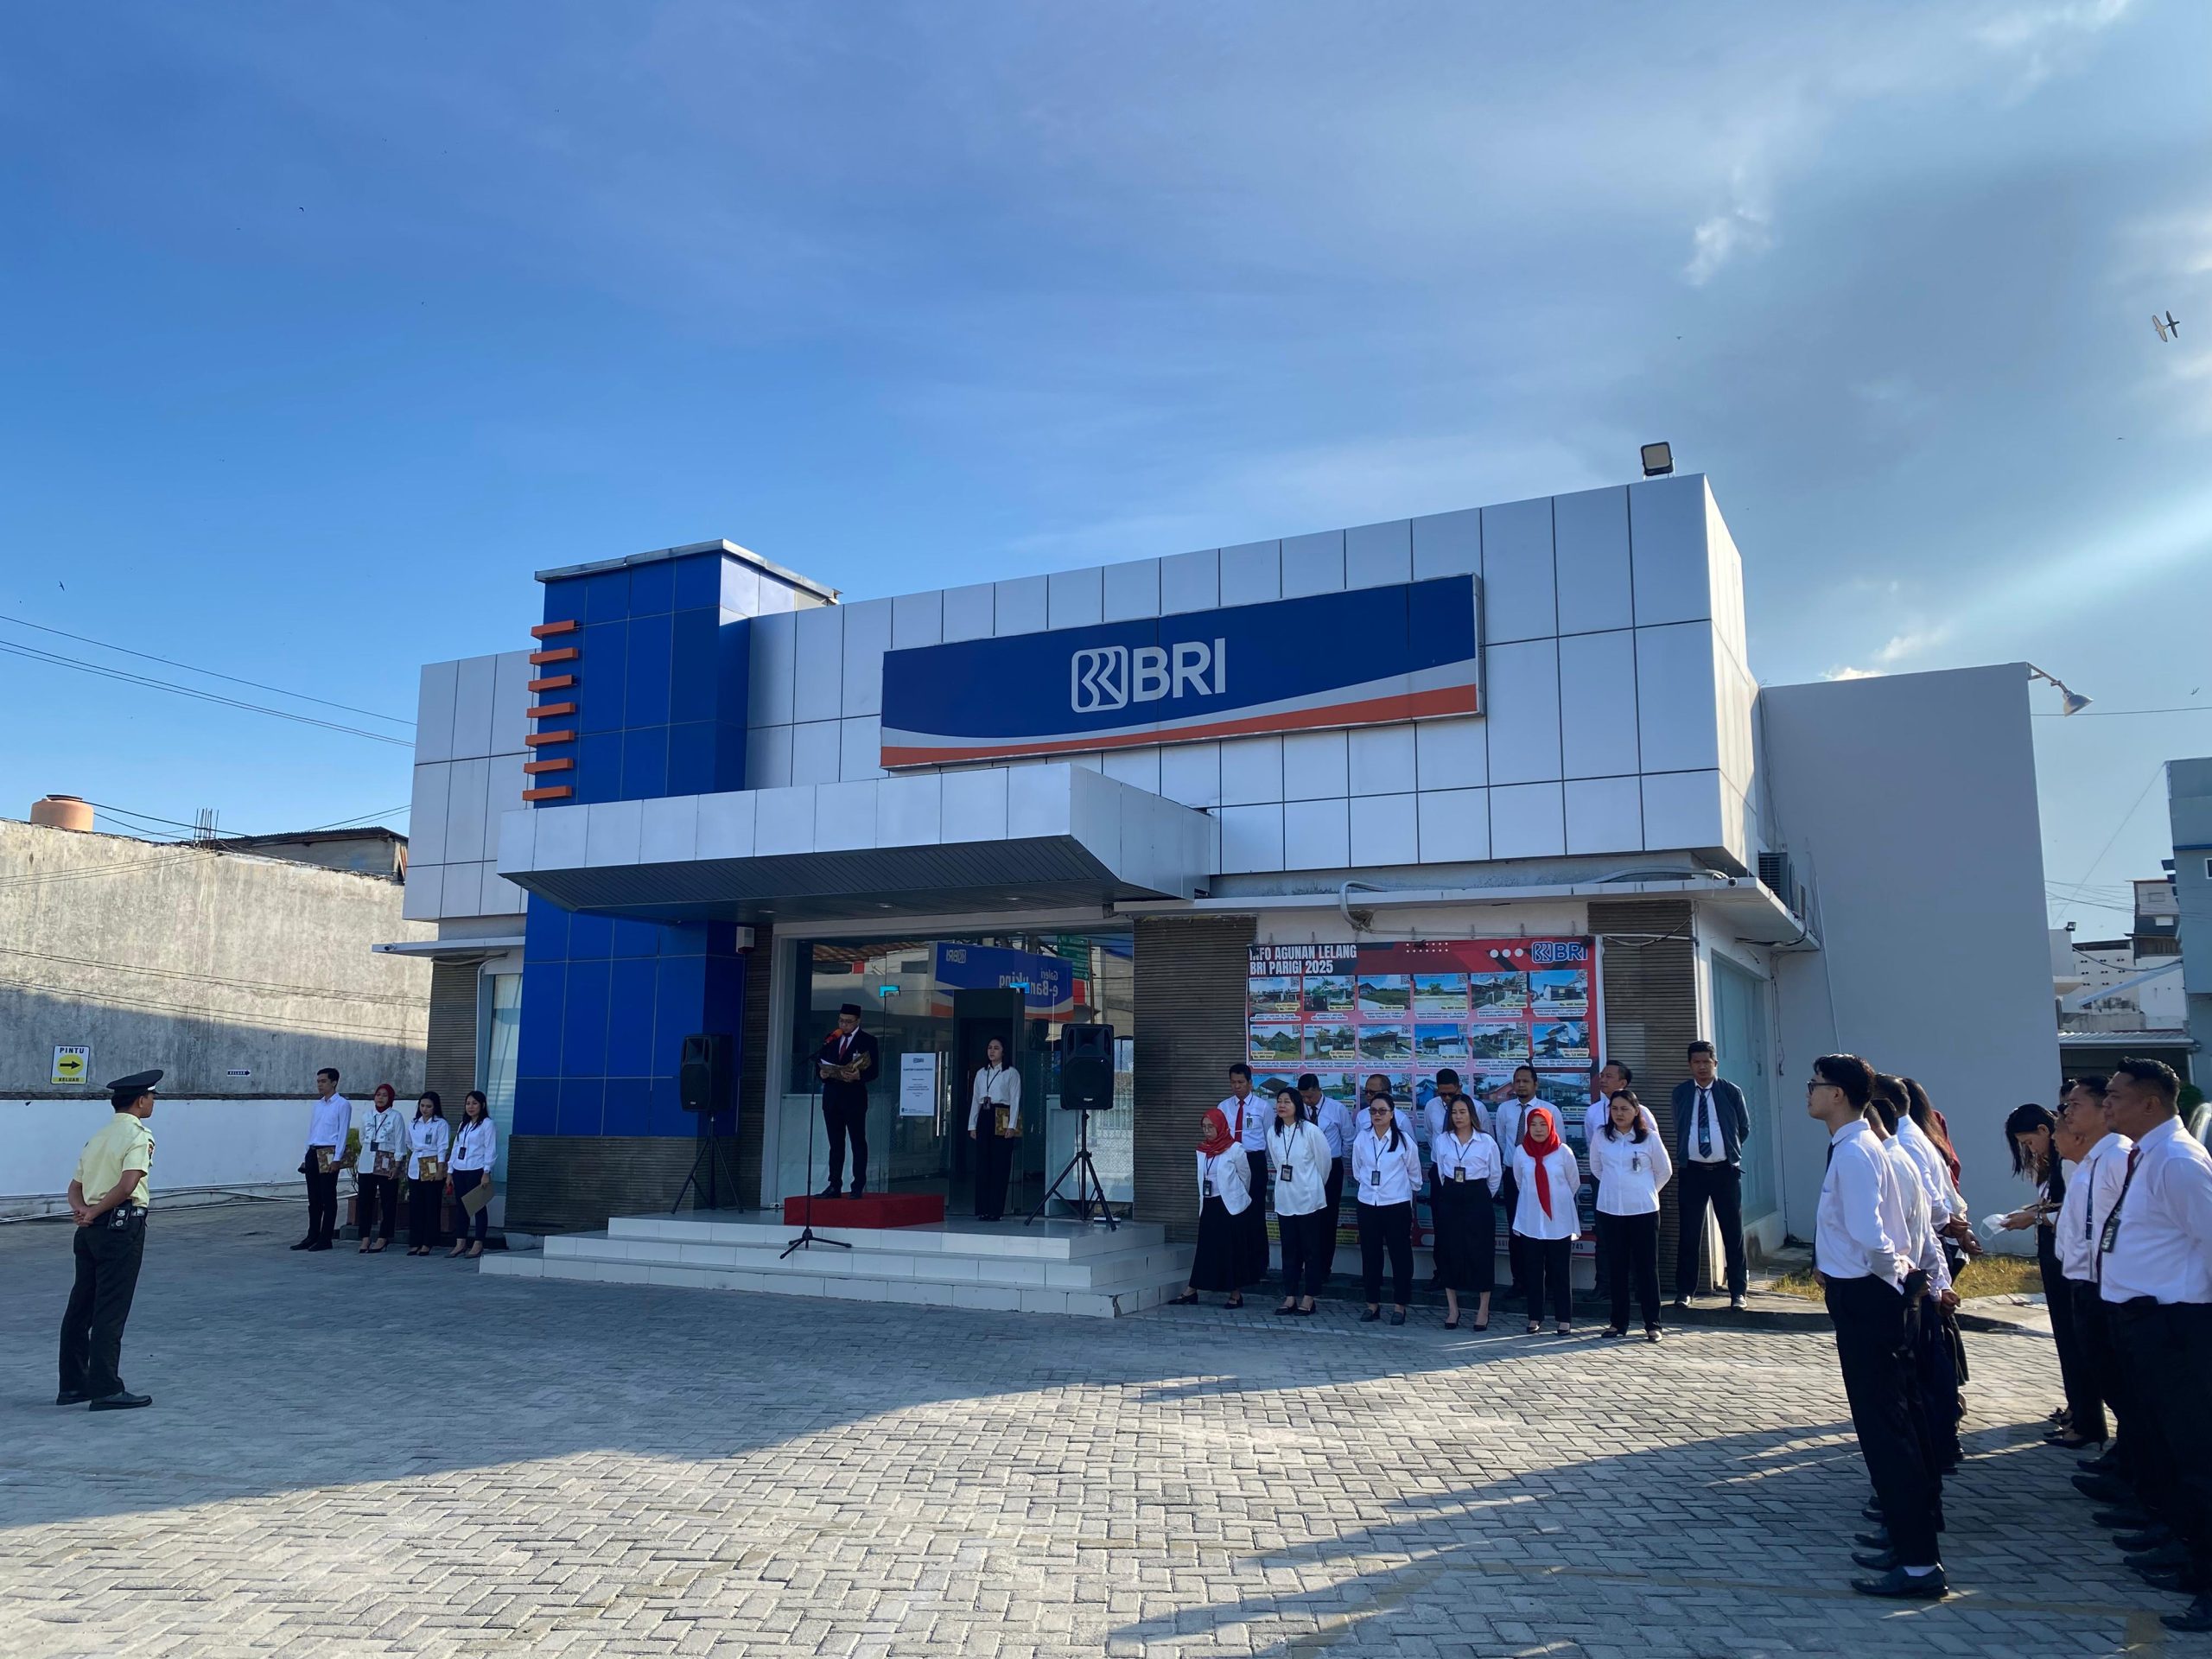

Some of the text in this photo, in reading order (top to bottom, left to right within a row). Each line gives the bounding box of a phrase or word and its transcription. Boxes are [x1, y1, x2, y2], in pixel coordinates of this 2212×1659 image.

[1133, 638, 1226, 702] BRI
[1274, 945, 1316, 961] AGUNAN
[1319, 944, 1357, 959] LELANG
[1554, 942, 1588, 961] BRI
[1249, 960, 1333, 976] BRI PARIGI 2025
